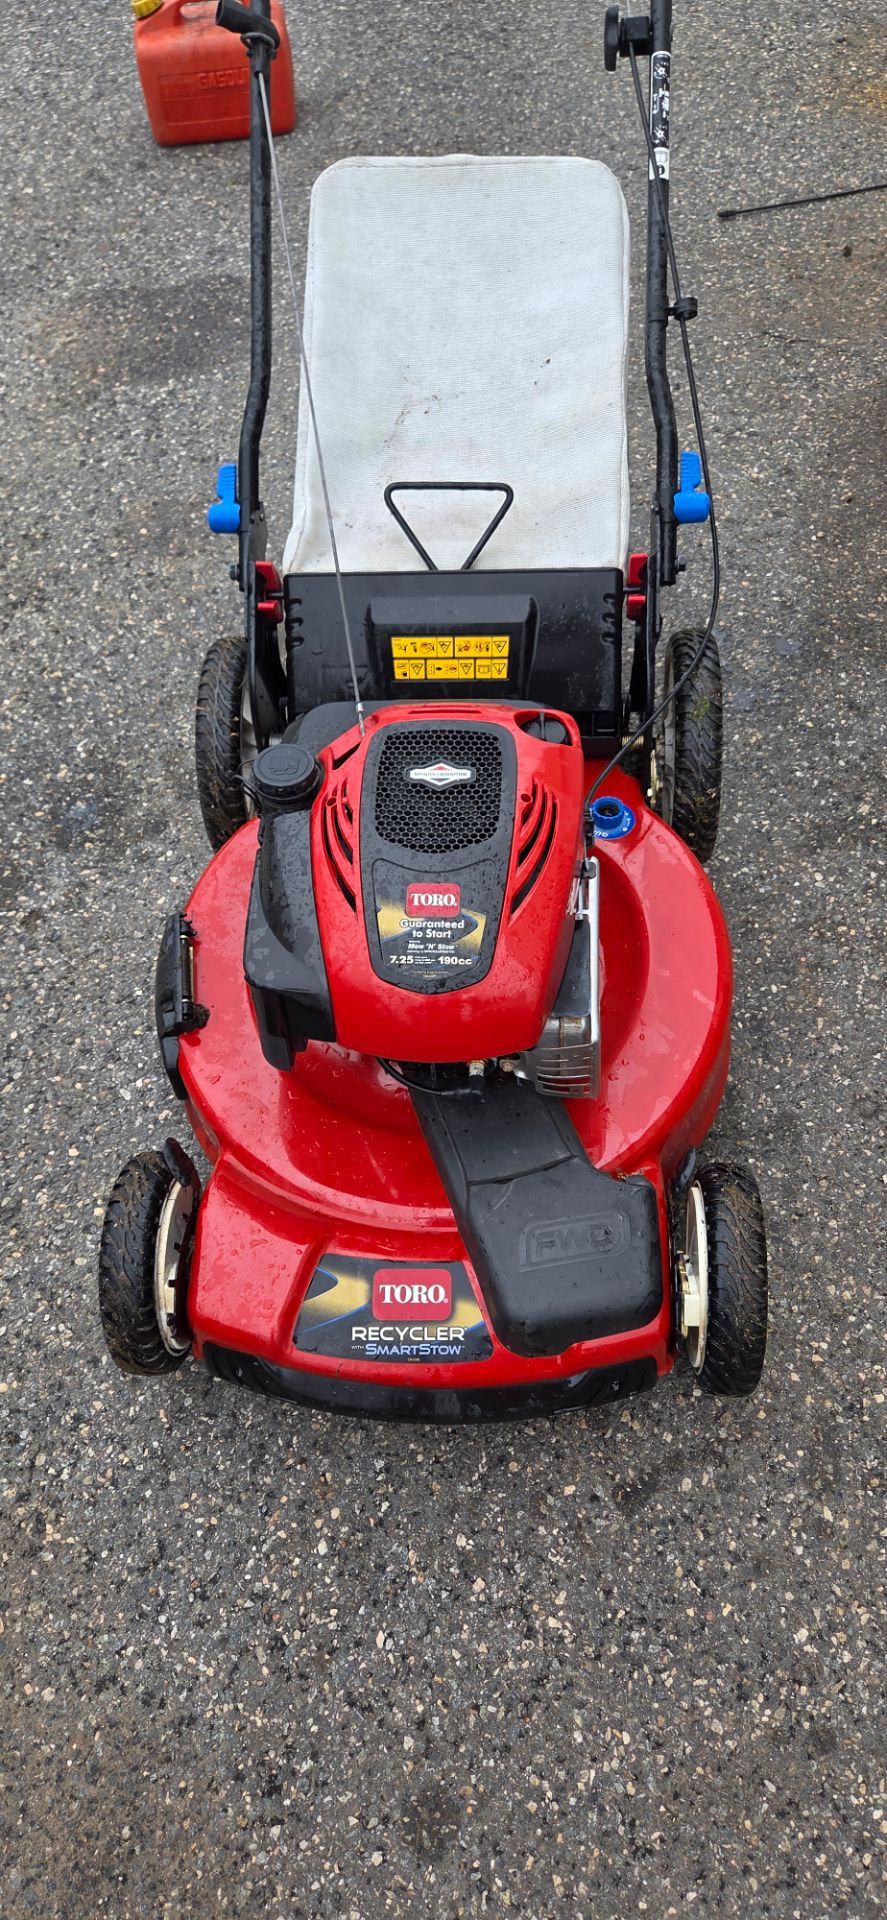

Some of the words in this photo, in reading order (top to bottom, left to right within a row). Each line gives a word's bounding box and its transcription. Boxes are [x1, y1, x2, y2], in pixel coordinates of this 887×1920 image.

[411, 893, 456, 907] TORO
[400, 919, 464, 929] Guaranteed
[412, 929, 423, 938] to
[426, 929, 451, 938] Start
[389, 955, 414, 964] 7.25
[438, 956, 472, 965] 190cc
[535, 1224, 613, 1255] FWD
[379, 1284, 445, 1304] TORO
[352, 1327, 464, 1341] RECYCLER
